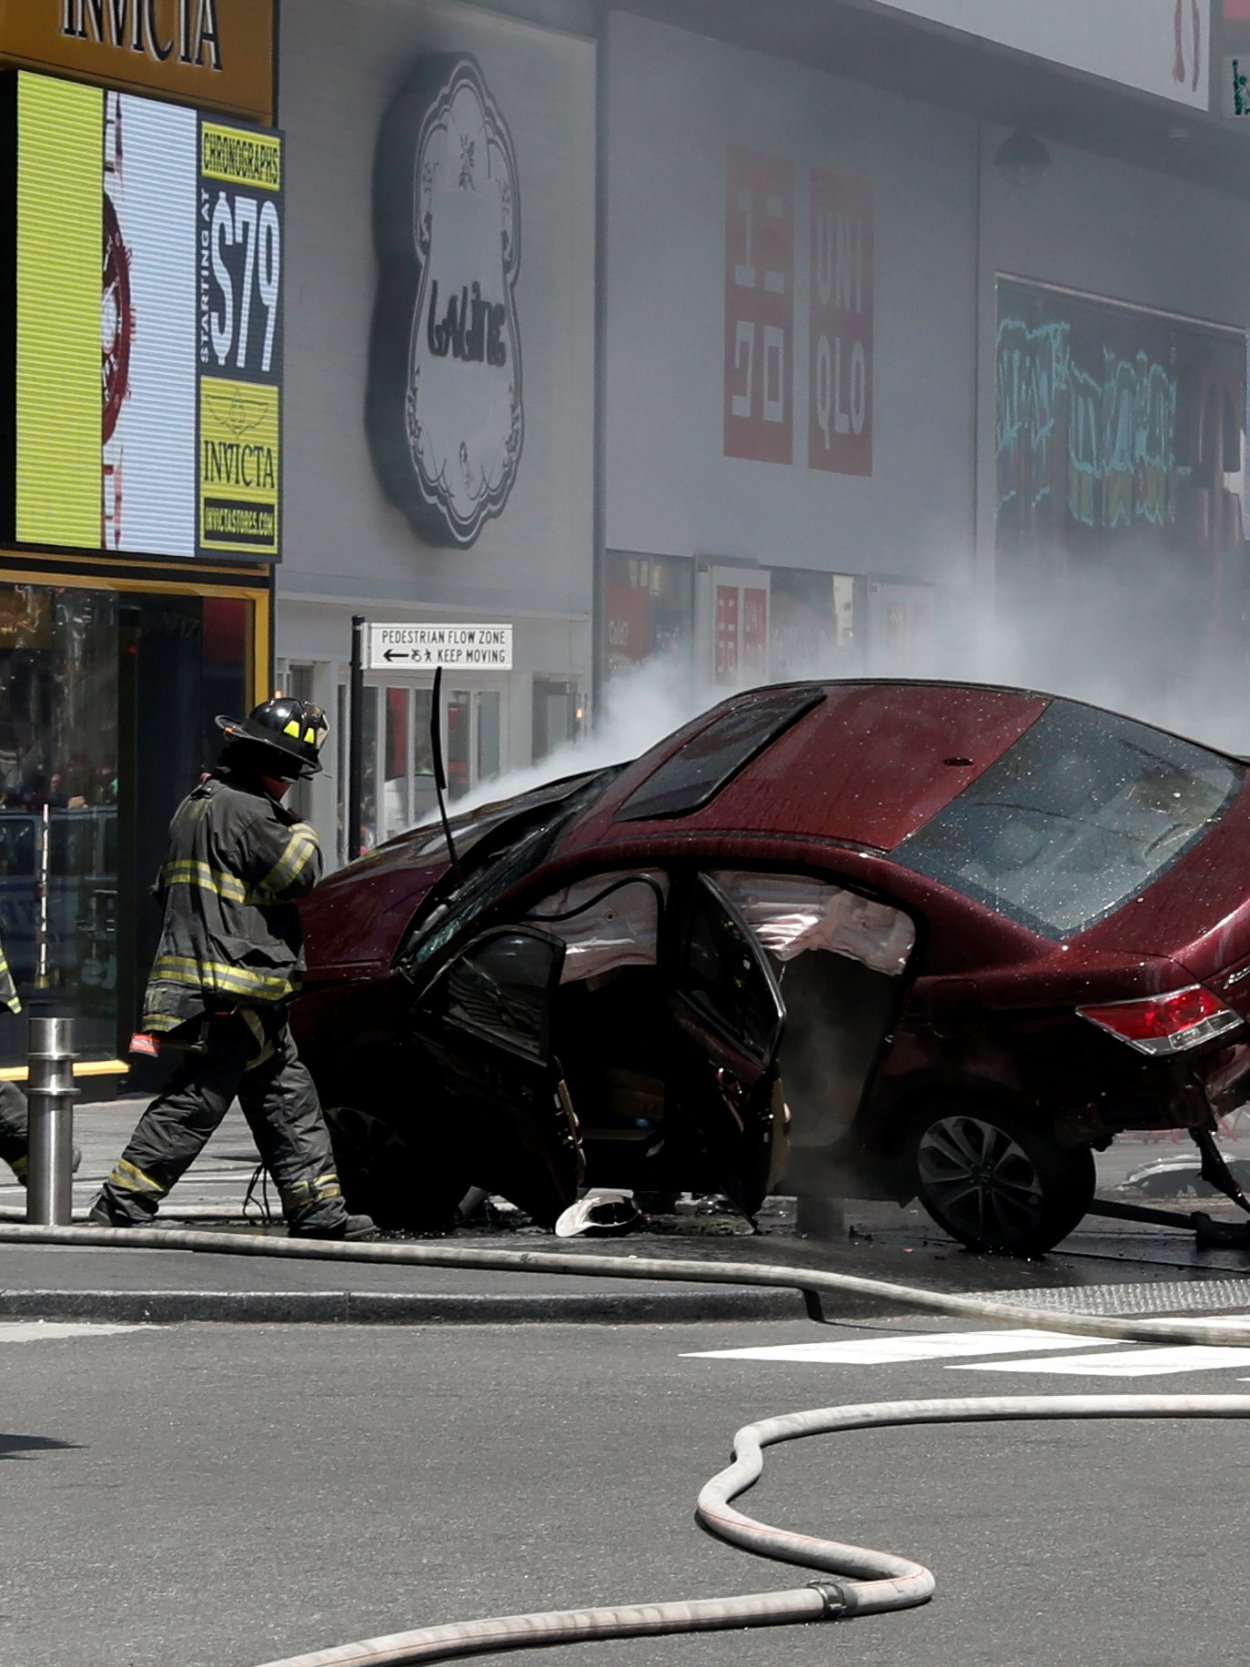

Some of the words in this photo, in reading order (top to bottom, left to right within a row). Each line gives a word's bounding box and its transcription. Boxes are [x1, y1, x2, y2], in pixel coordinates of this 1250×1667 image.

[203, 131, 280, 185] CHRONOGRAPHS
[200, 188, 210, 222] AT
[210, 191, 280, 372] $79
[815, 208, 864, 313] UNI
[200, 230, 210, 364] STARTING
[815, 333, 867, 449] QLO
[203, 439, 276, 489] INVICTA
[382, 630, 445, 644] PEDESTRIAN
[448, 631, 475, 644] FLOW
[478, 631, 506, 644] ZONE
[437, 650, 462, 663] KEEP
[465, 650, 506, 663] MOVING
